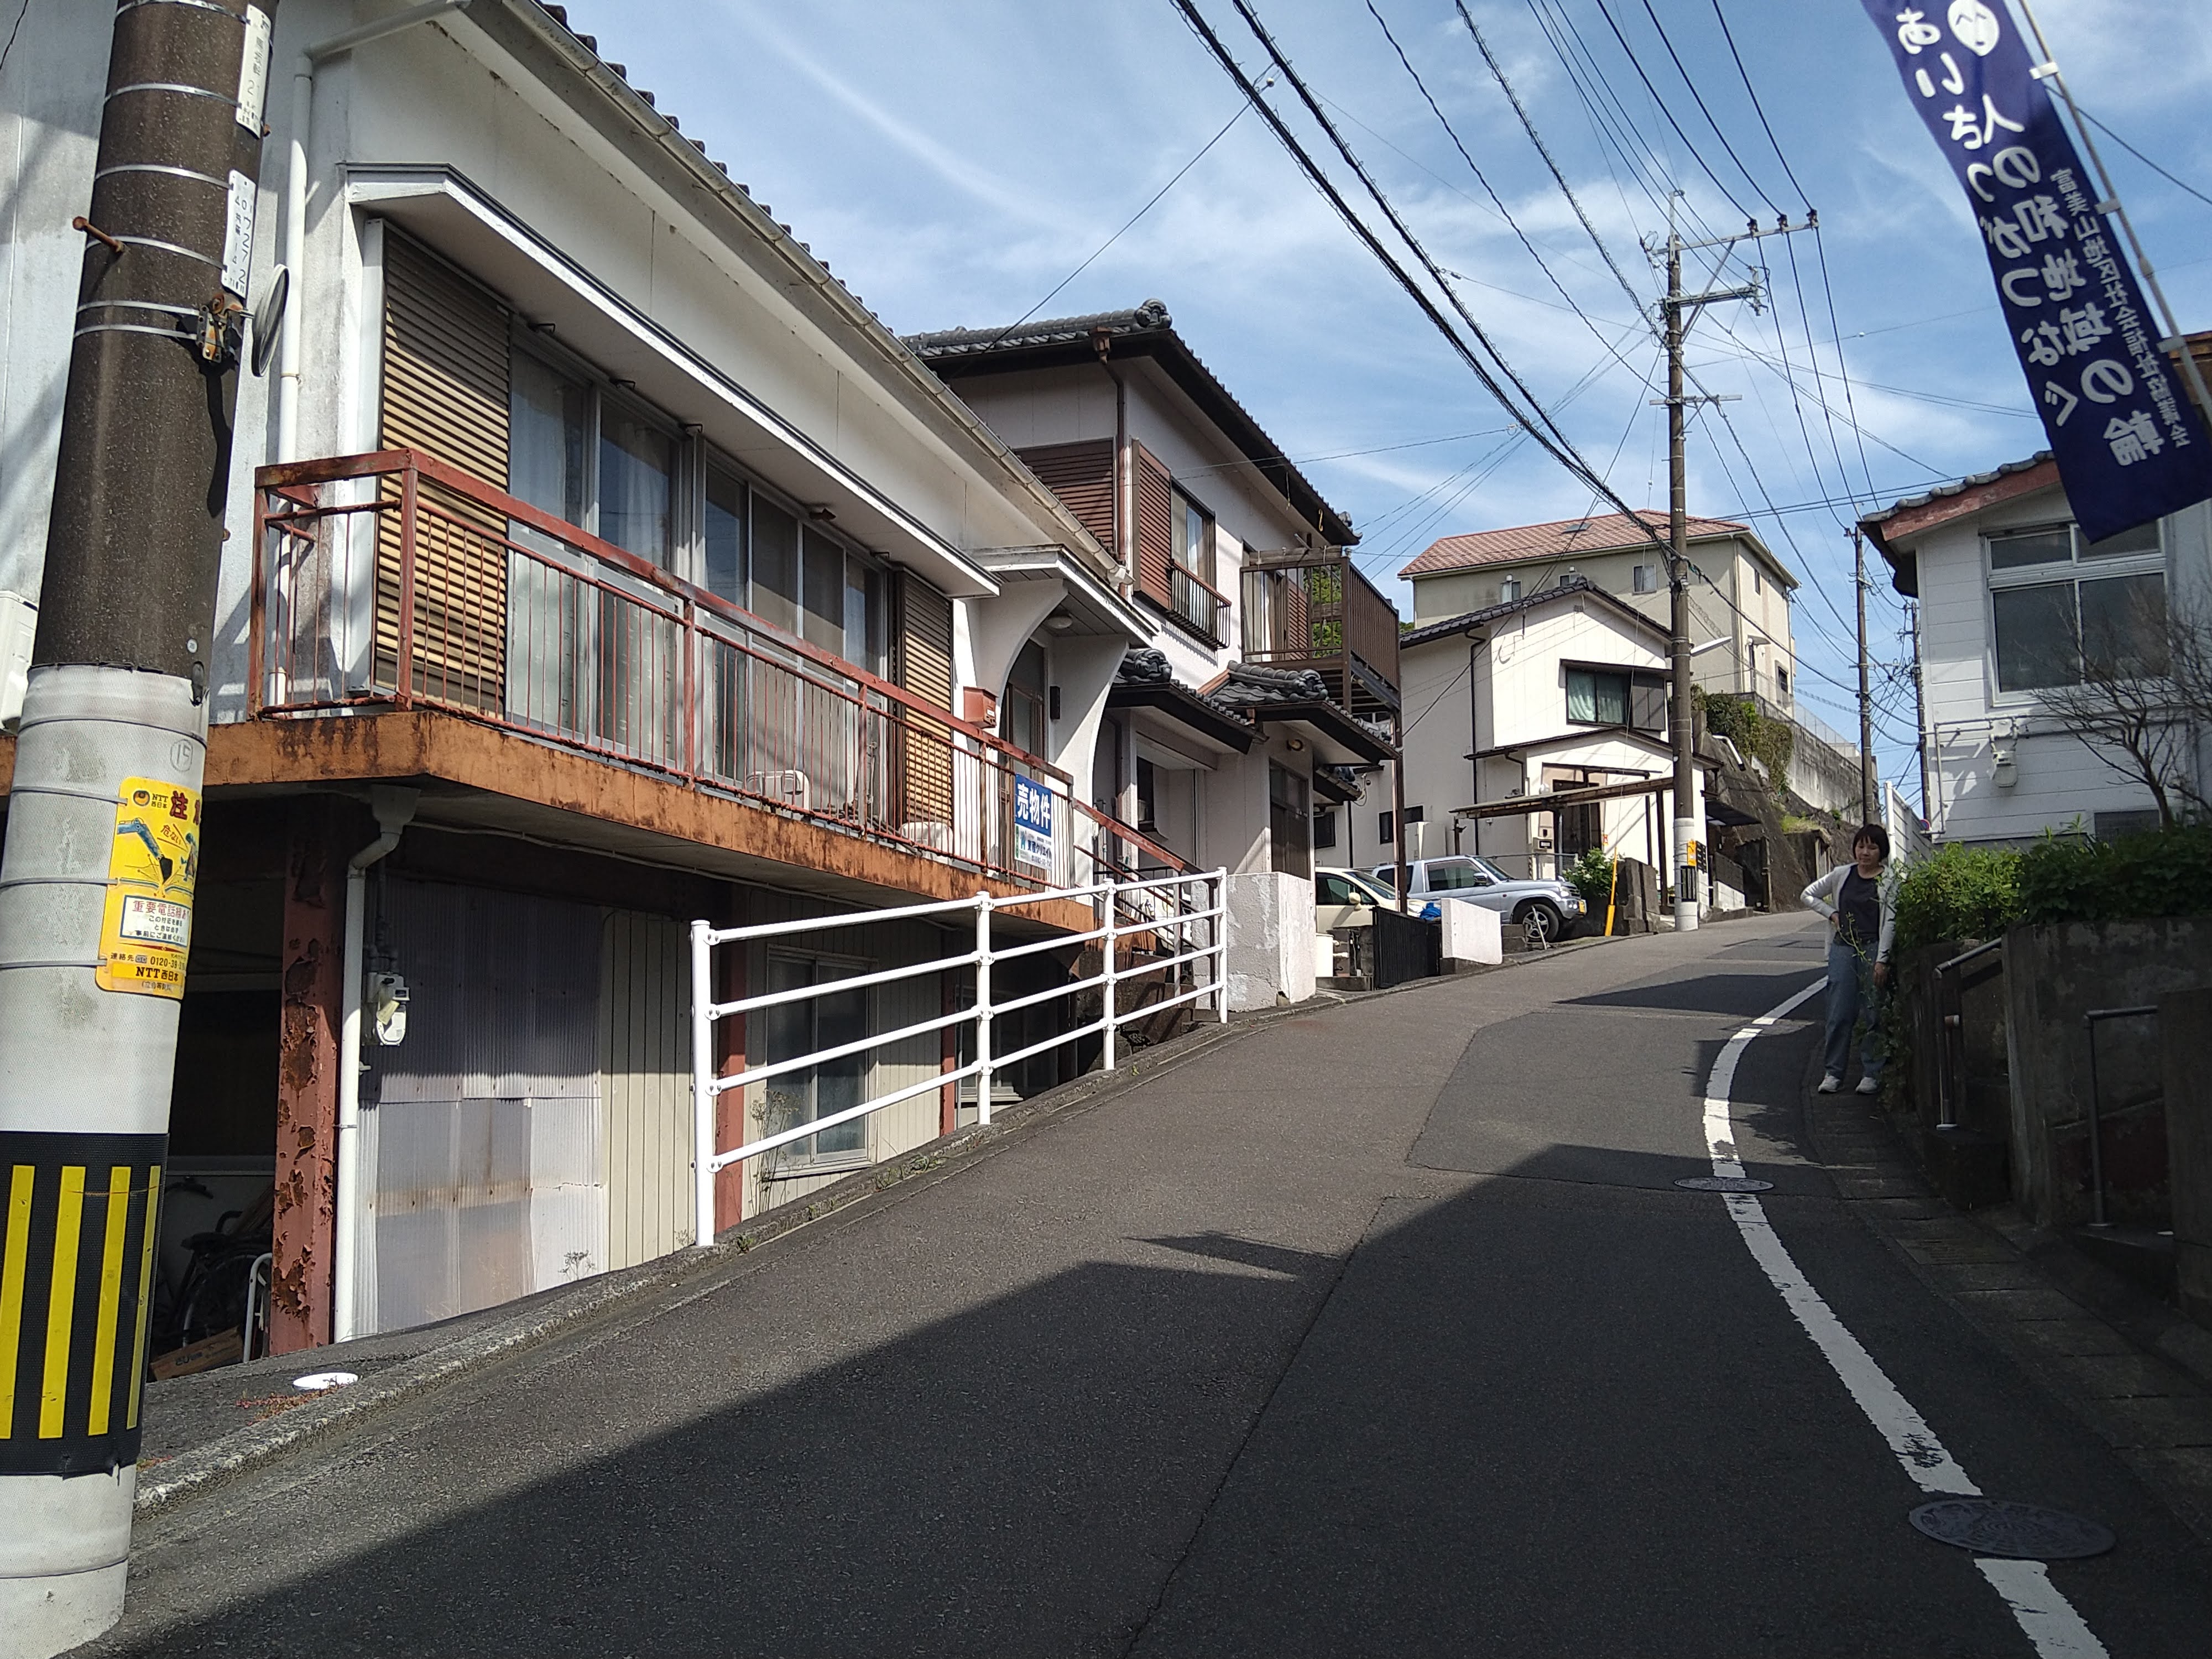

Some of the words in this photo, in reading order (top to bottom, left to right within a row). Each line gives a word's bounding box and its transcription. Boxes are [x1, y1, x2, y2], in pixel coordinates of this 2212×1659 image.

[1017, 783, 1051, 830] 売物件
[160, 824, 181, 845] 危ない
[110, 952, 134, 962] 連絡先
